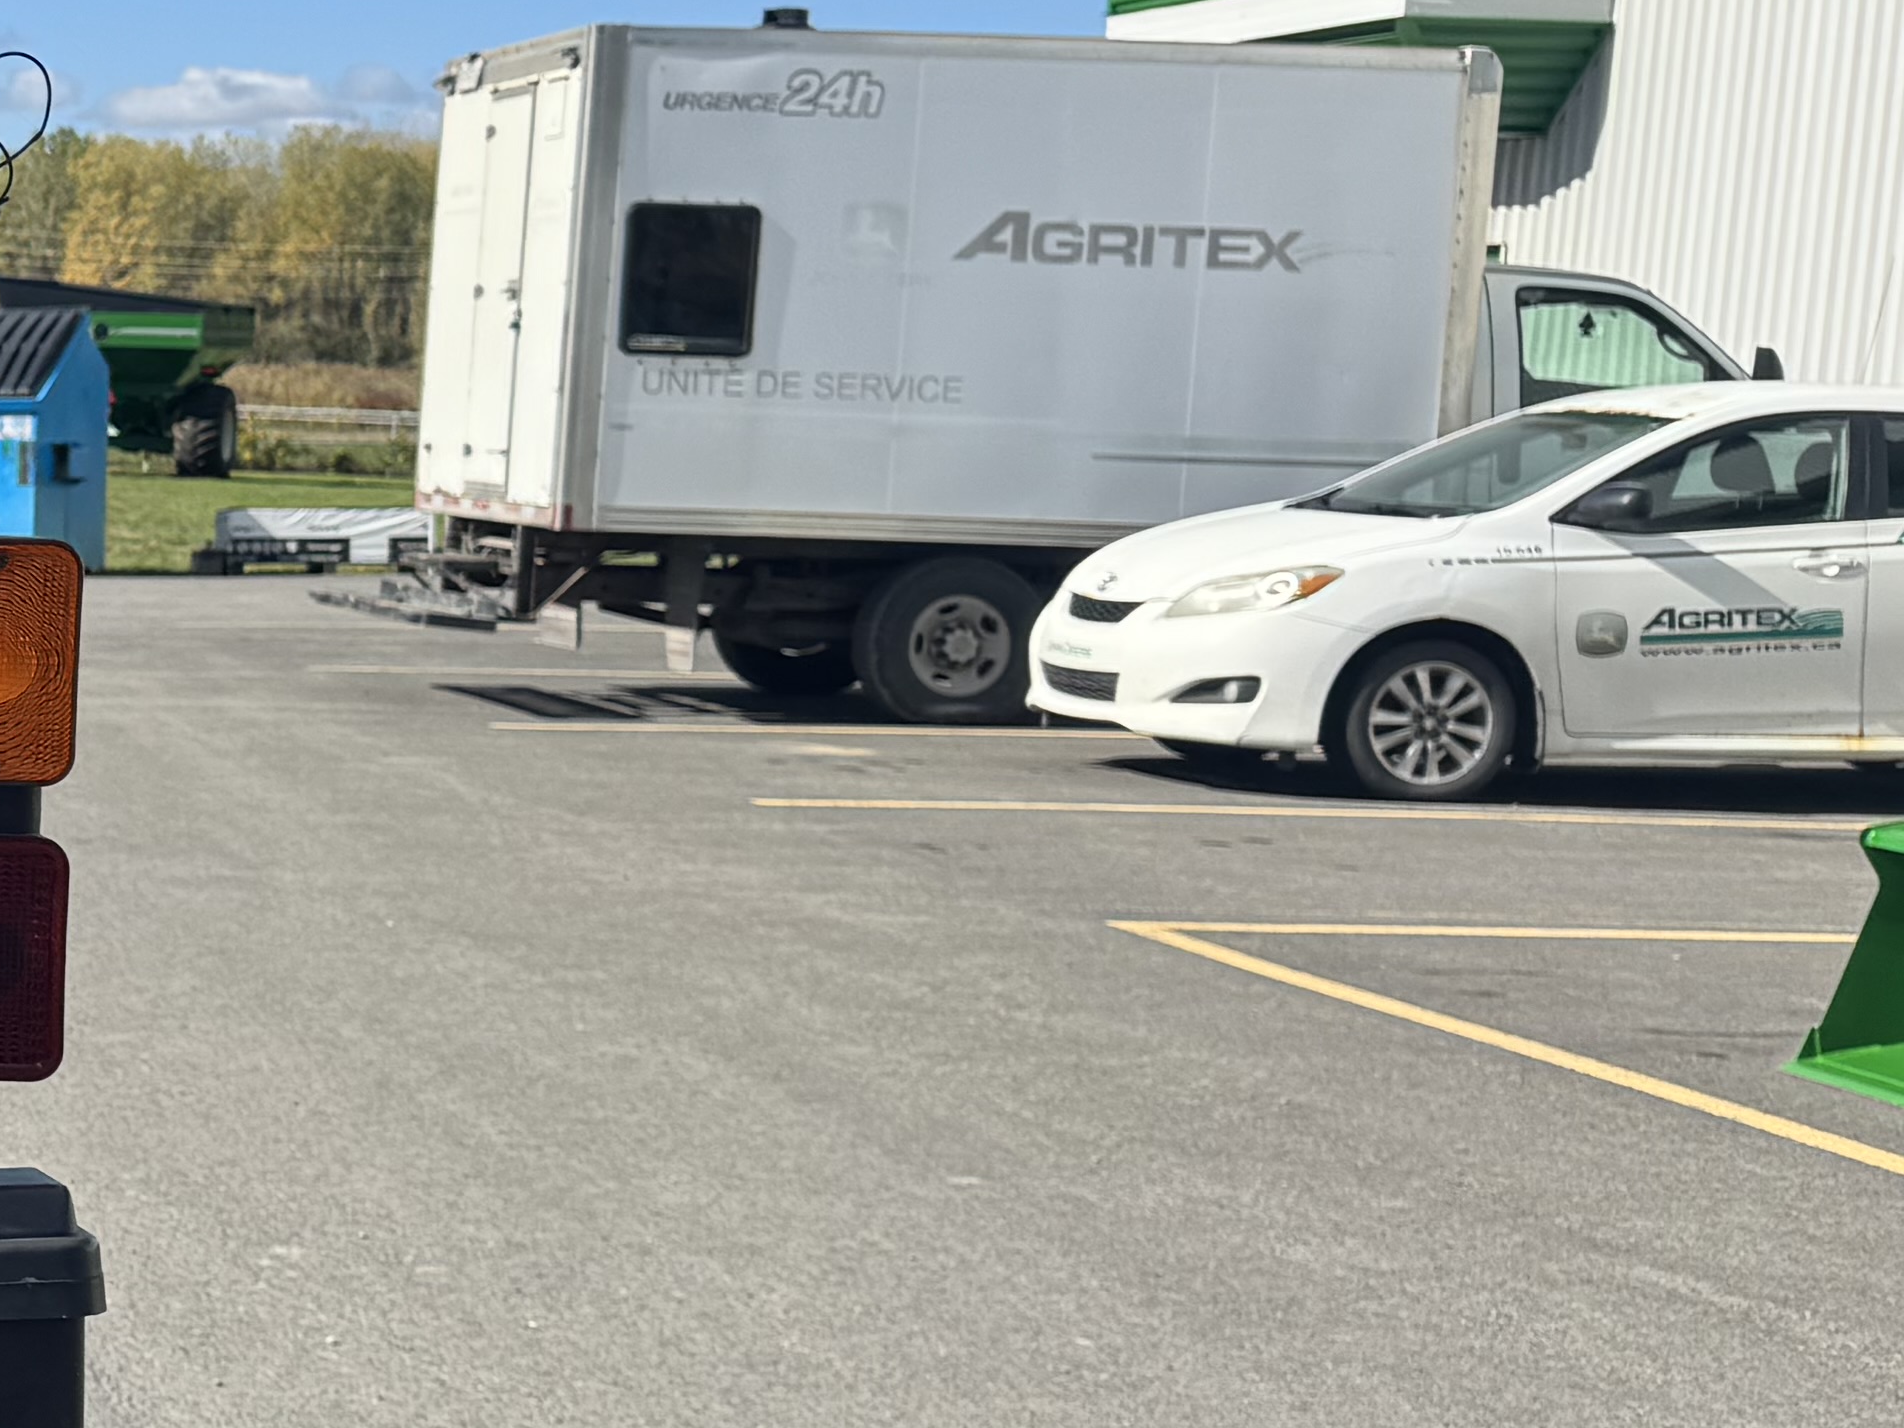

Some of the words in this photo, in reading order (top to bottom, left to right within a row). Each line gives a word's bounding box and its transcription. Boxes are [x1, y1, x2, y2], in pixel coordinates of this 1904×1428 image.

[662, 90, 780, 113] URGENCE
[778, 67, 885, 118] 24h
[952, 210, 1304, 272] AGRITEX
[755, 373, 801, 399] DE
[814, 372, 964, 404] SERVICE
[1642, 607, 1800, 632] AGRITEX
